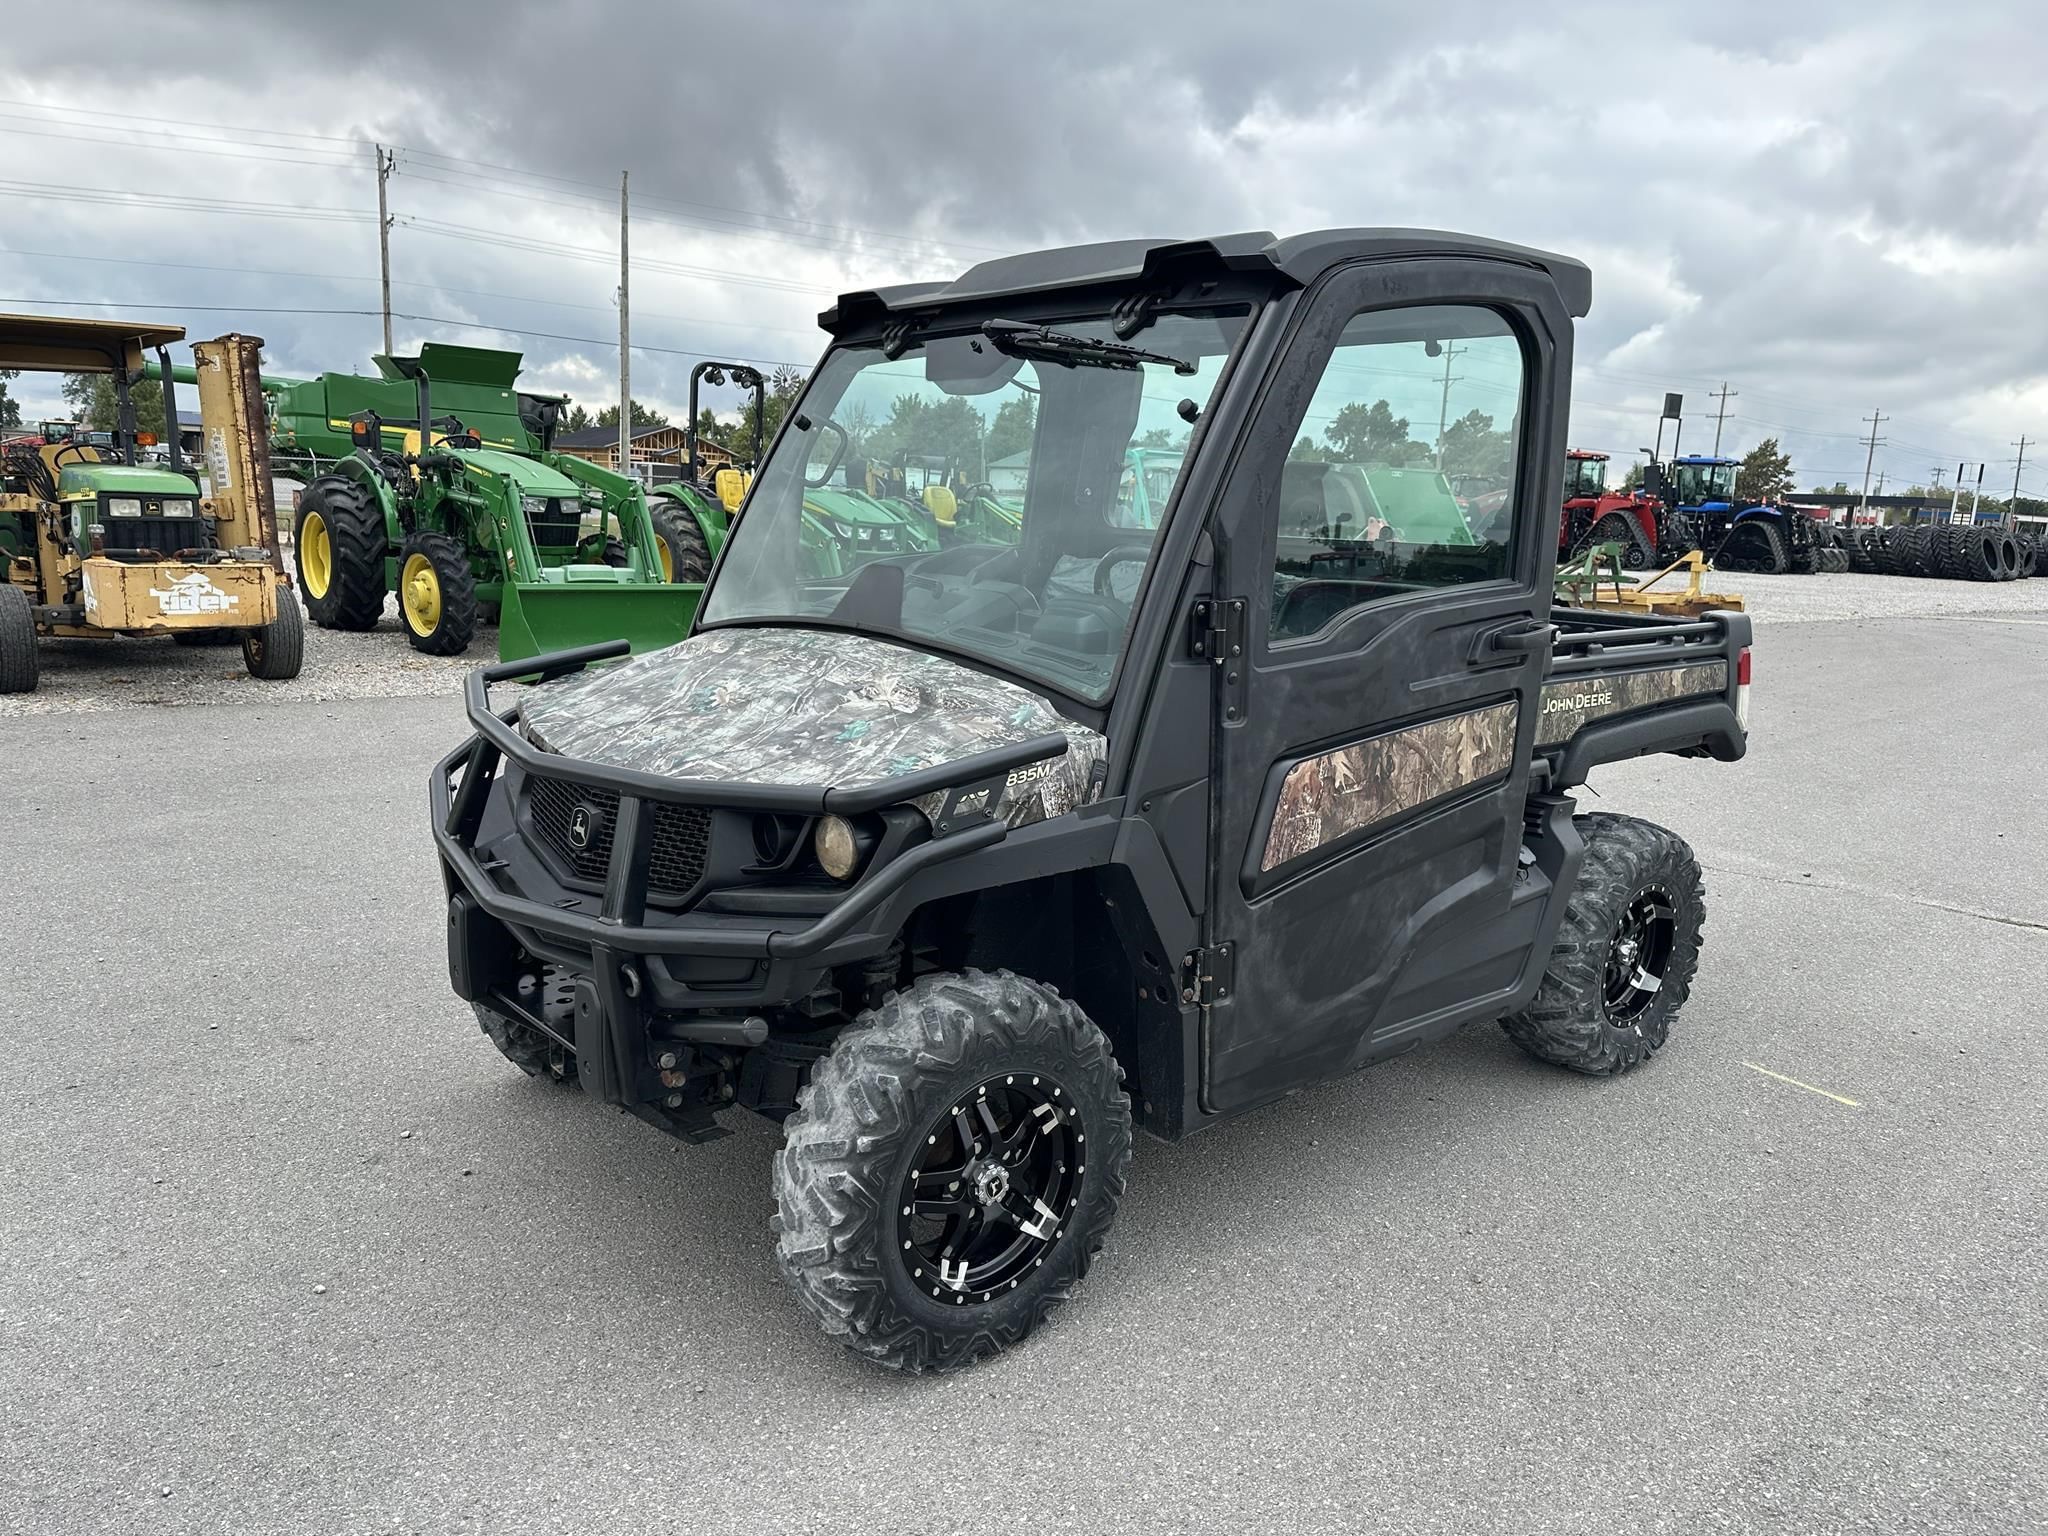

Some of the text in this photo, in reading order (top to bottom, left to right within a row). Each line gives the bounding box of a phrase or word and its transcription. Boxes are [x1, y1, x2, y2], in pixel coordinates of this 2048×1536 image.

[1542, 693, 1612, 714] JOHN DEERE
[1006, 763, 1050, 787] 835M
